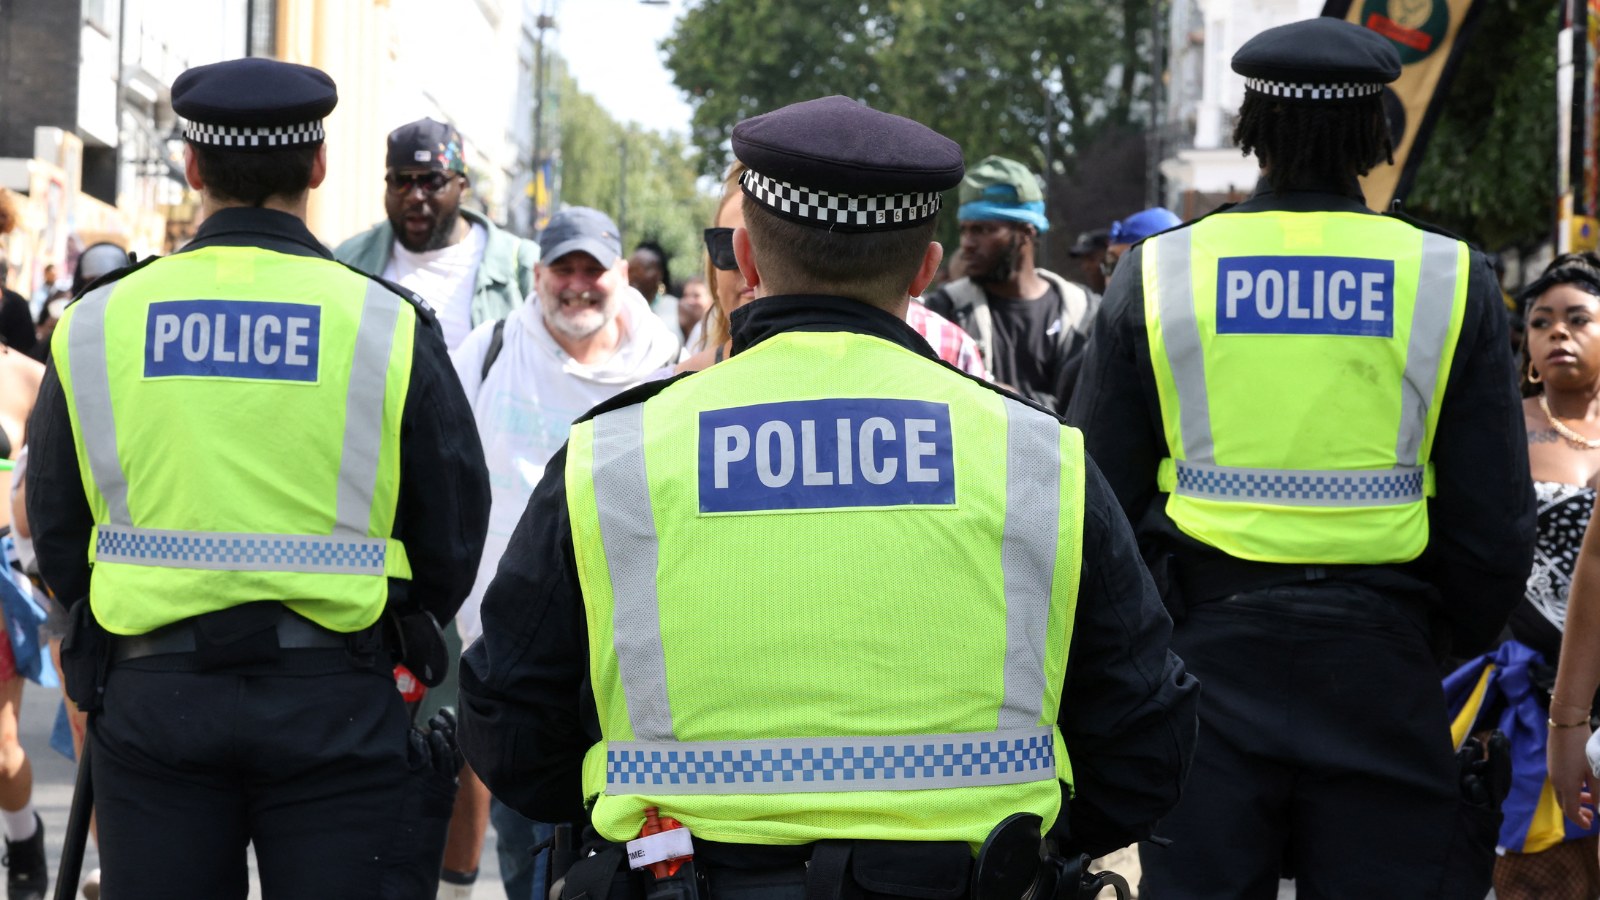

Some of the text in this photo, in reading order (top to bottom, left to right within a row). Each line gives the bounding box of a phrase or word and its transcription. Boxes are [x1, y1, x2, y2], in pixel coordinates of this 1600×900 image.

[1226, 269, 1385, 321] POLICE
[153, 312, 310, 366] POLICE
[714, 416, 940, 489] POLICE
